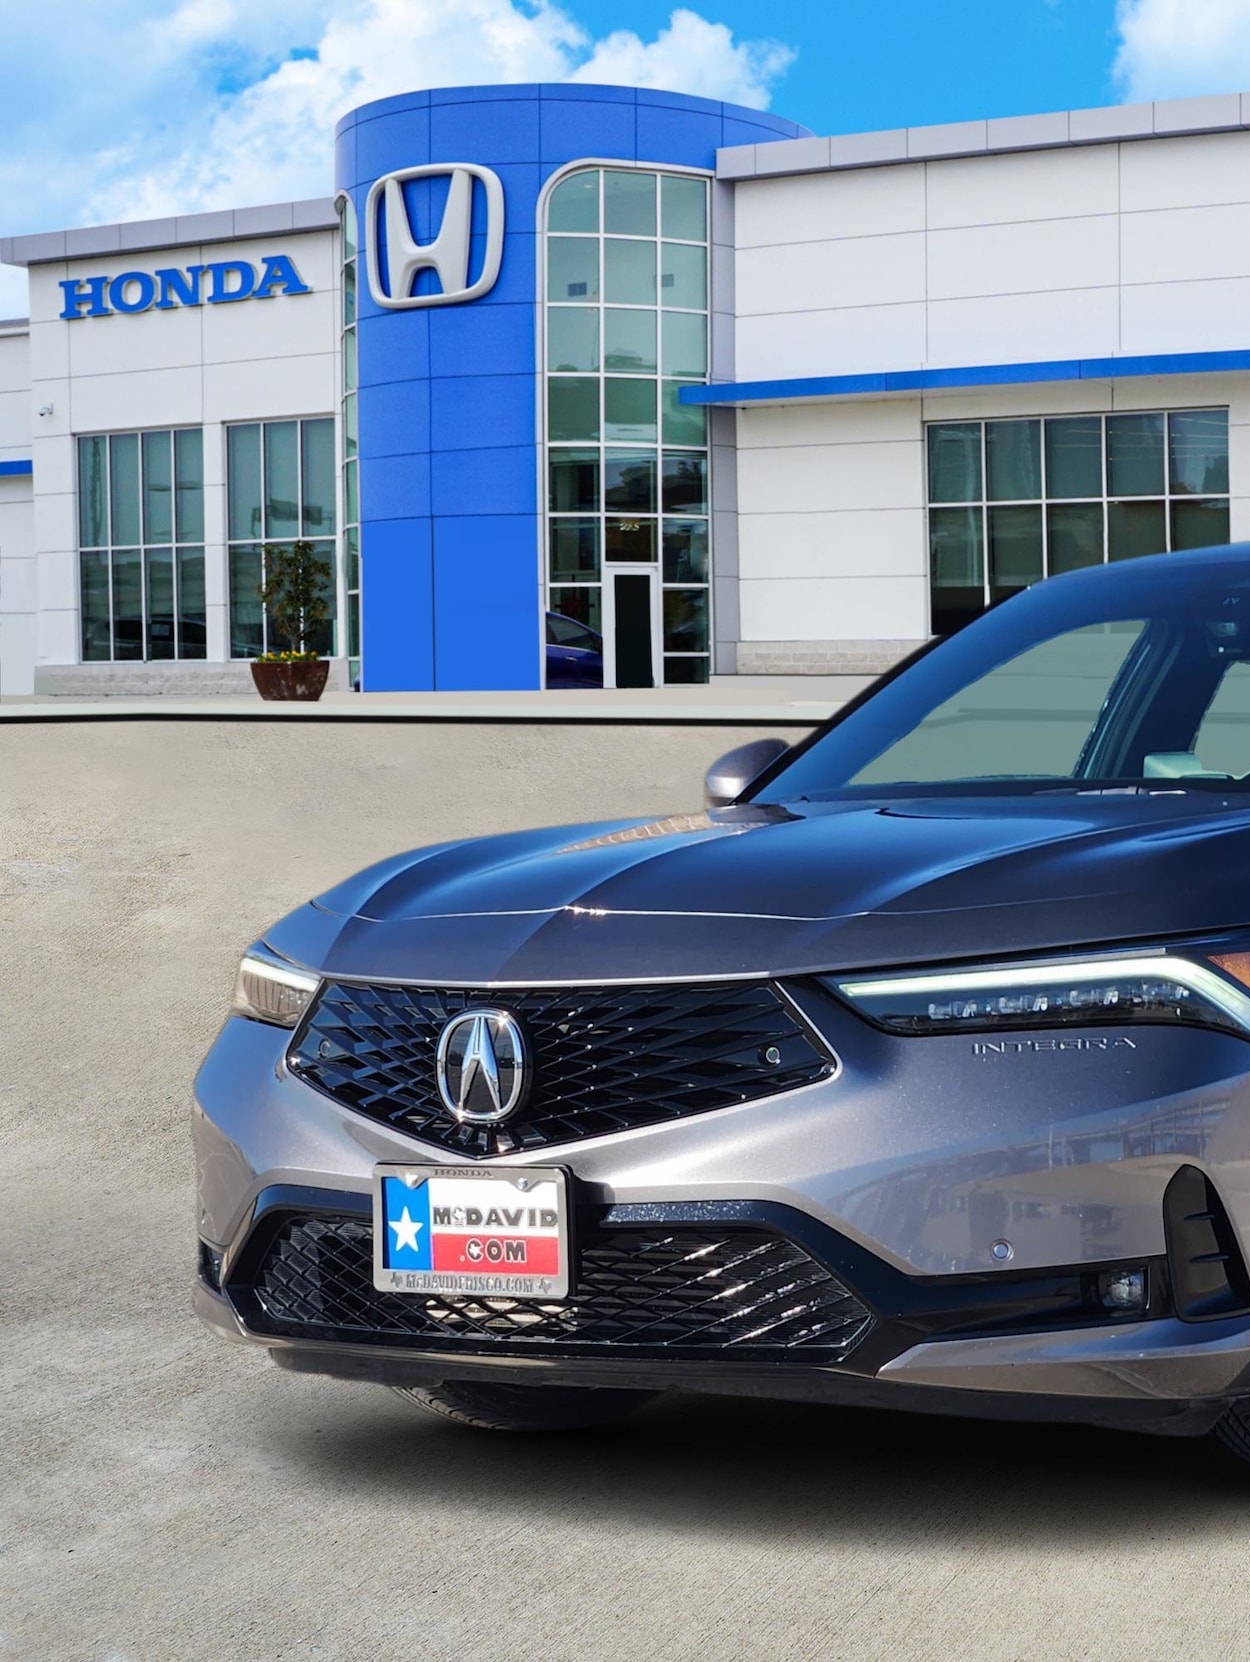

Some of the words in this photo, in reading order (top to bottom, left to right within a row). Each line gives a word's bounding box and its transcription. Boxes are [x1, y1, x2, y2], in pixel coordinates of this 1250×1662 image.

[59, 255, 312, 320] HONDA
[972, 1037, 1137, 1055] INTEGRA
[434, 1168, 493, 1177] HONDA
